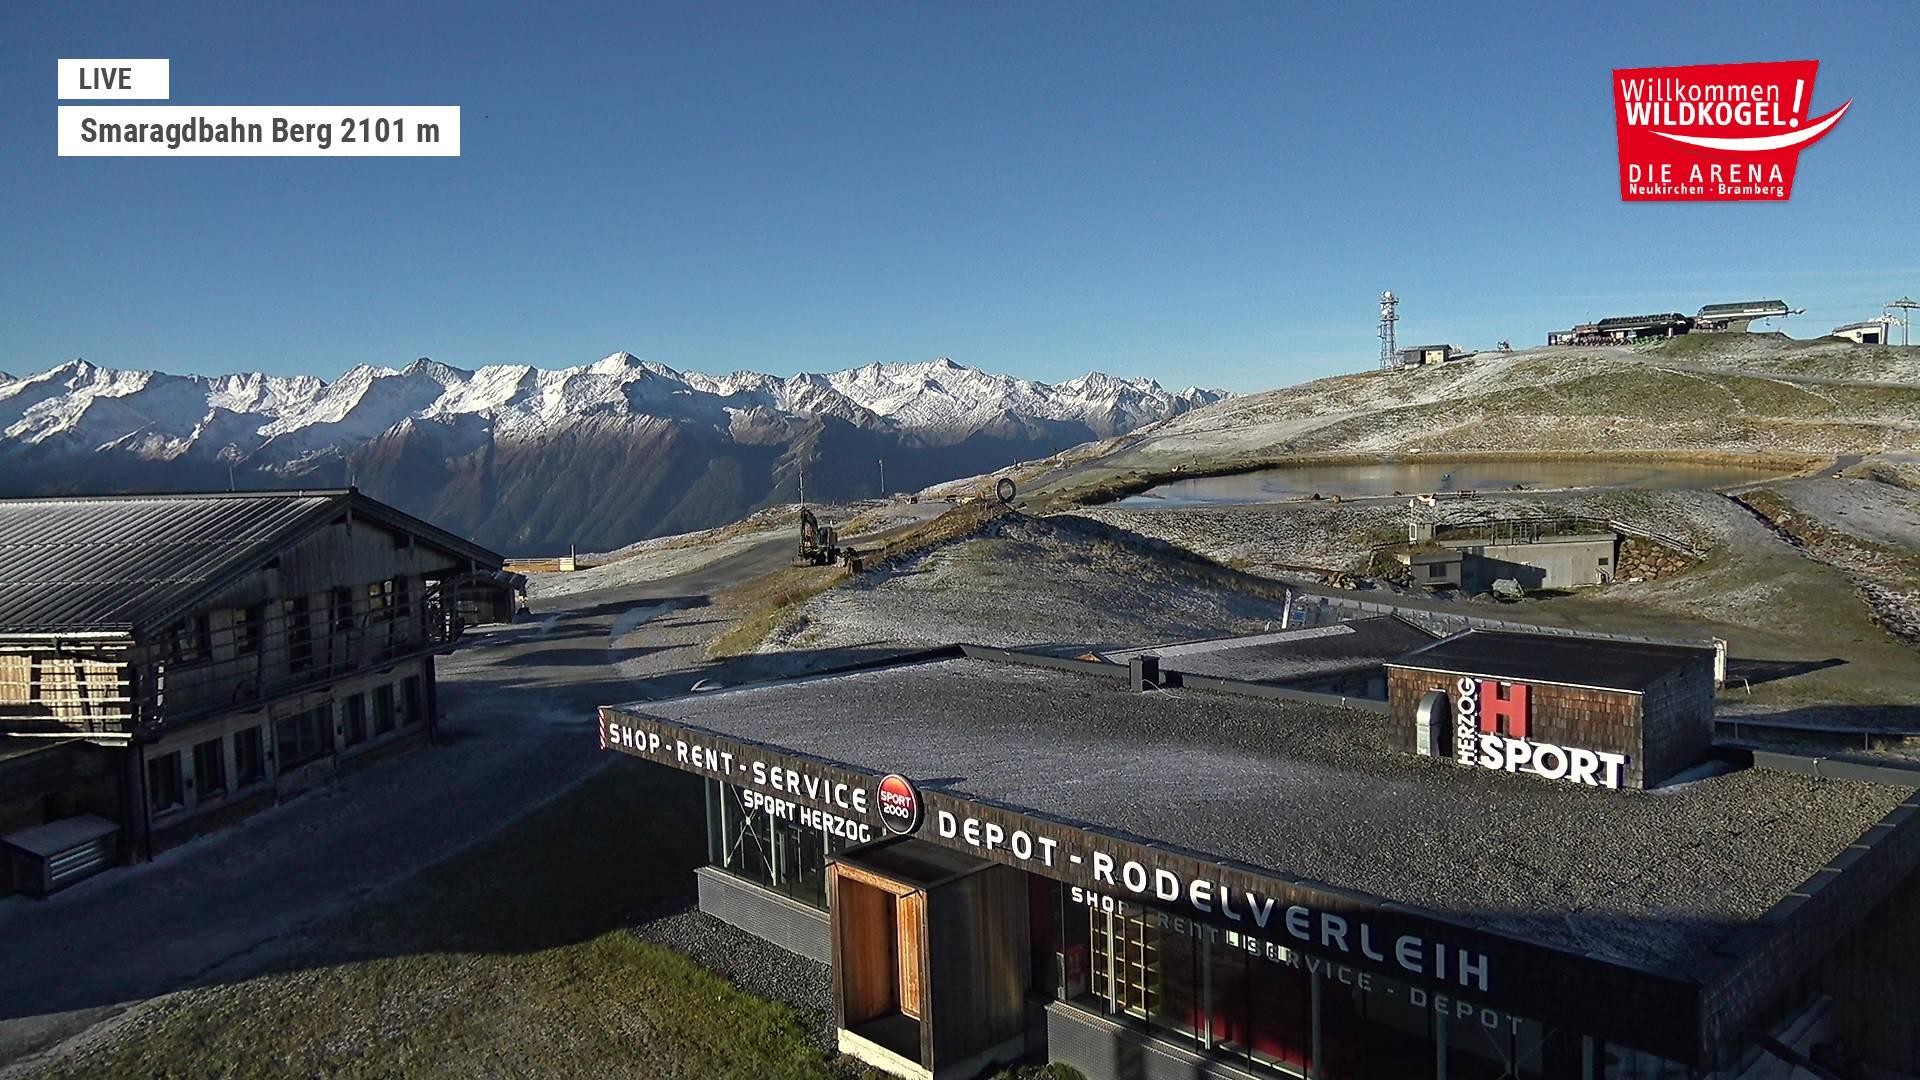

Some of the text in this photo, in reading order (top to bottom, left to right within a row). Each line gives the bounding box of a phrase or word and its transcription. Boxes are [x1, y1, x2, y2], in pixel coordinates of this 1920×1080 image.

[1457, 677, 1476, 766] HERZOG
[1480, 680, 1528, 738] H
[609, 723, 661, 753] SHOP
[677, 740, 733, 775] RENT
[752, 761, 868, 814] SERVICE
[1479, 734, 1625, 790] SPORT
[743, 789, 871, 843] SPORT HERZOG
[880, 790, 912, 808] SPORT
[883, 802, 909, 819] 2000
[938, 810, 1058, 867] DEPOT
[1093, 851, 1489, 992] RODELVERLEIH
[1158, 911, 1220, 944] RENT
[1410, 986, 1522, 1036] DEPOT
